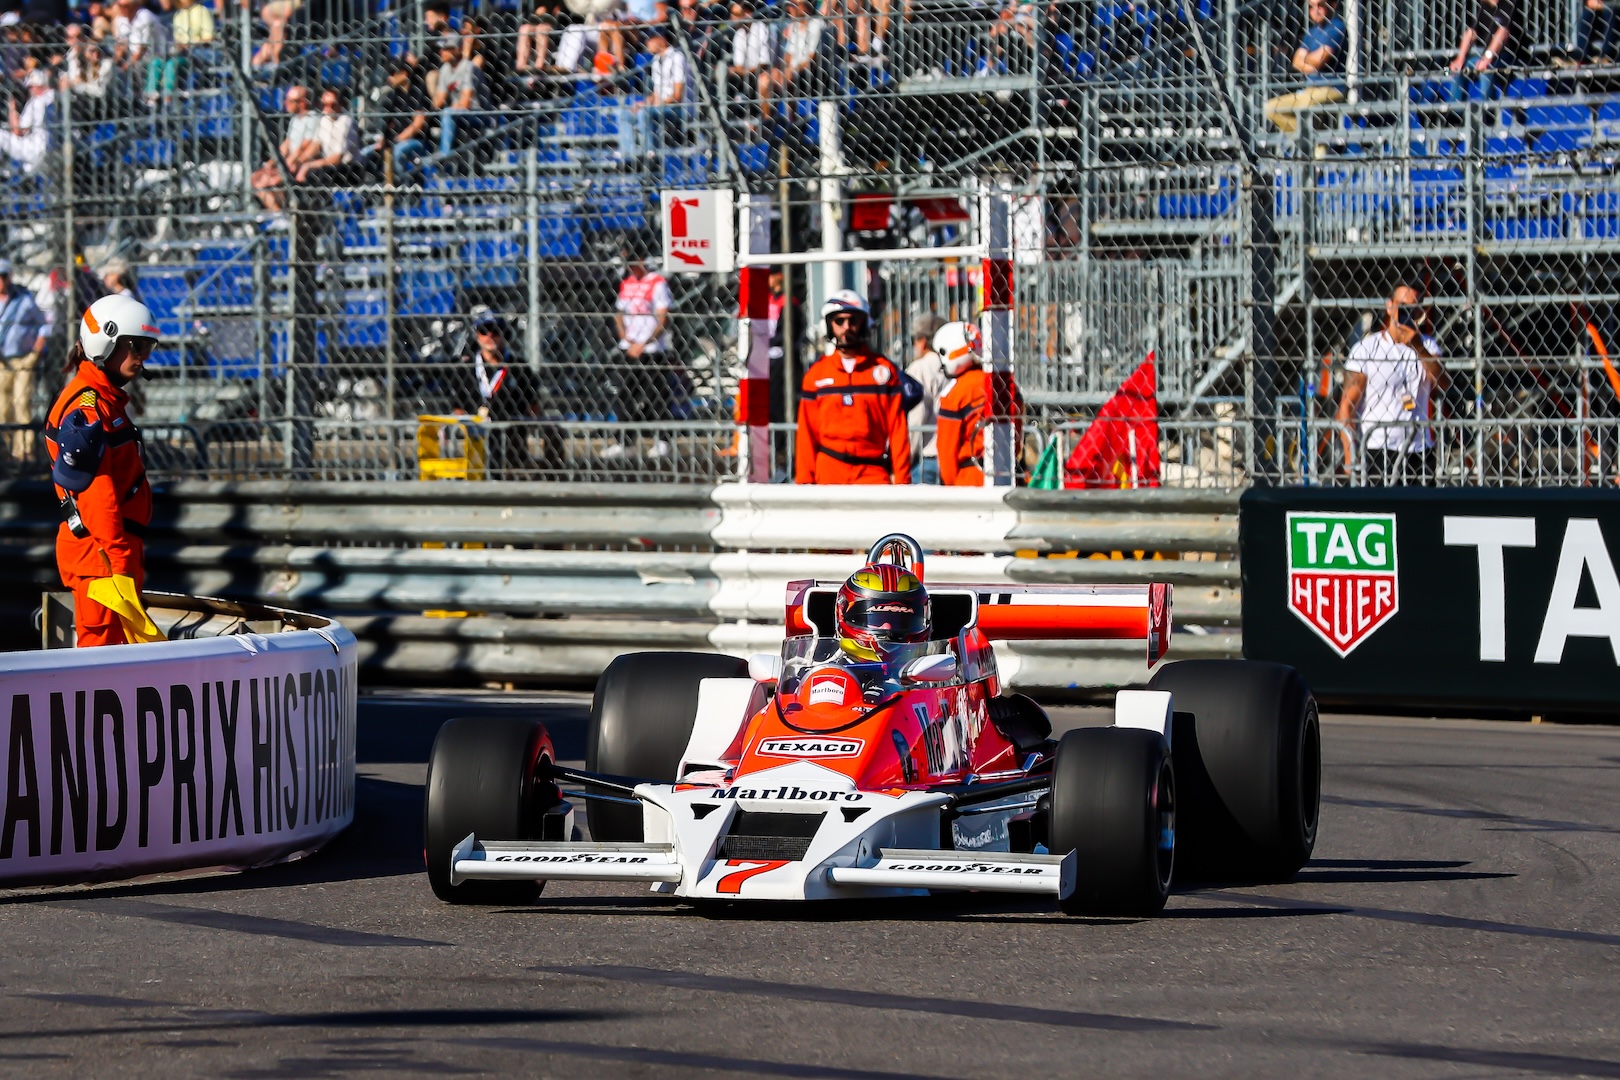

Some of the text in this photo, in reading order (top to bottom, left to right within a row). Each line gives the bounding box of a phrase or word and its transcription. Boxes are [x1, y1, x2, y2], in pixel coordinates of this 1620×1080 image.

[671, 240, 709, 249] FIRE
[1297, 522, 1387, 566] TAG
[1294, 577, 1392, 645] HEUER
[812, 687, 844, 695] Marlboro
[766, 743, 856, 752] TEXACO
[136, 679, 245, 848] PRIX
[709, 786, 863, 802] Marlboro
[716, 859, 788, 893] 7
